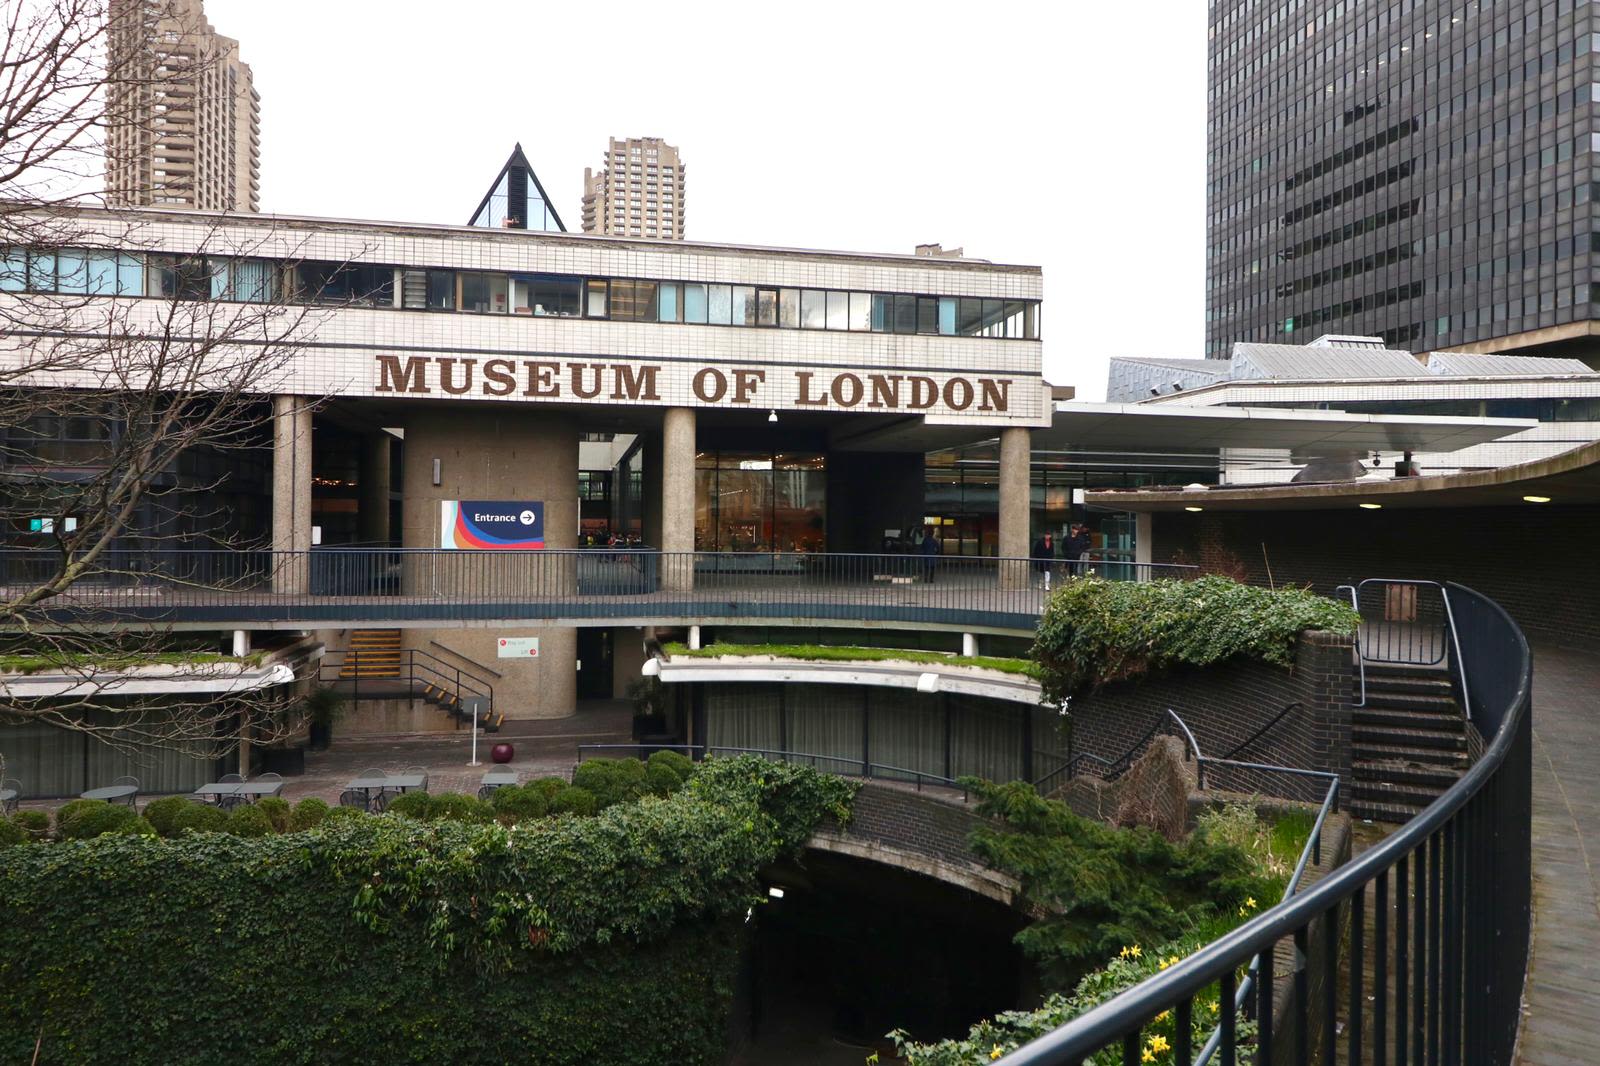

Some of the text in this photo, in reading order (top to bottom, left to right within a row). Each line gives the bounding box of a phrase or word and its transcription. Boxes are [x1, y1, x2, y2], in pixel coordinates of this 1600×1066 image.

[375, 355, 1012, 411] MUSEUM OF LONDON
[474, 513, 516, 522] Entrance
